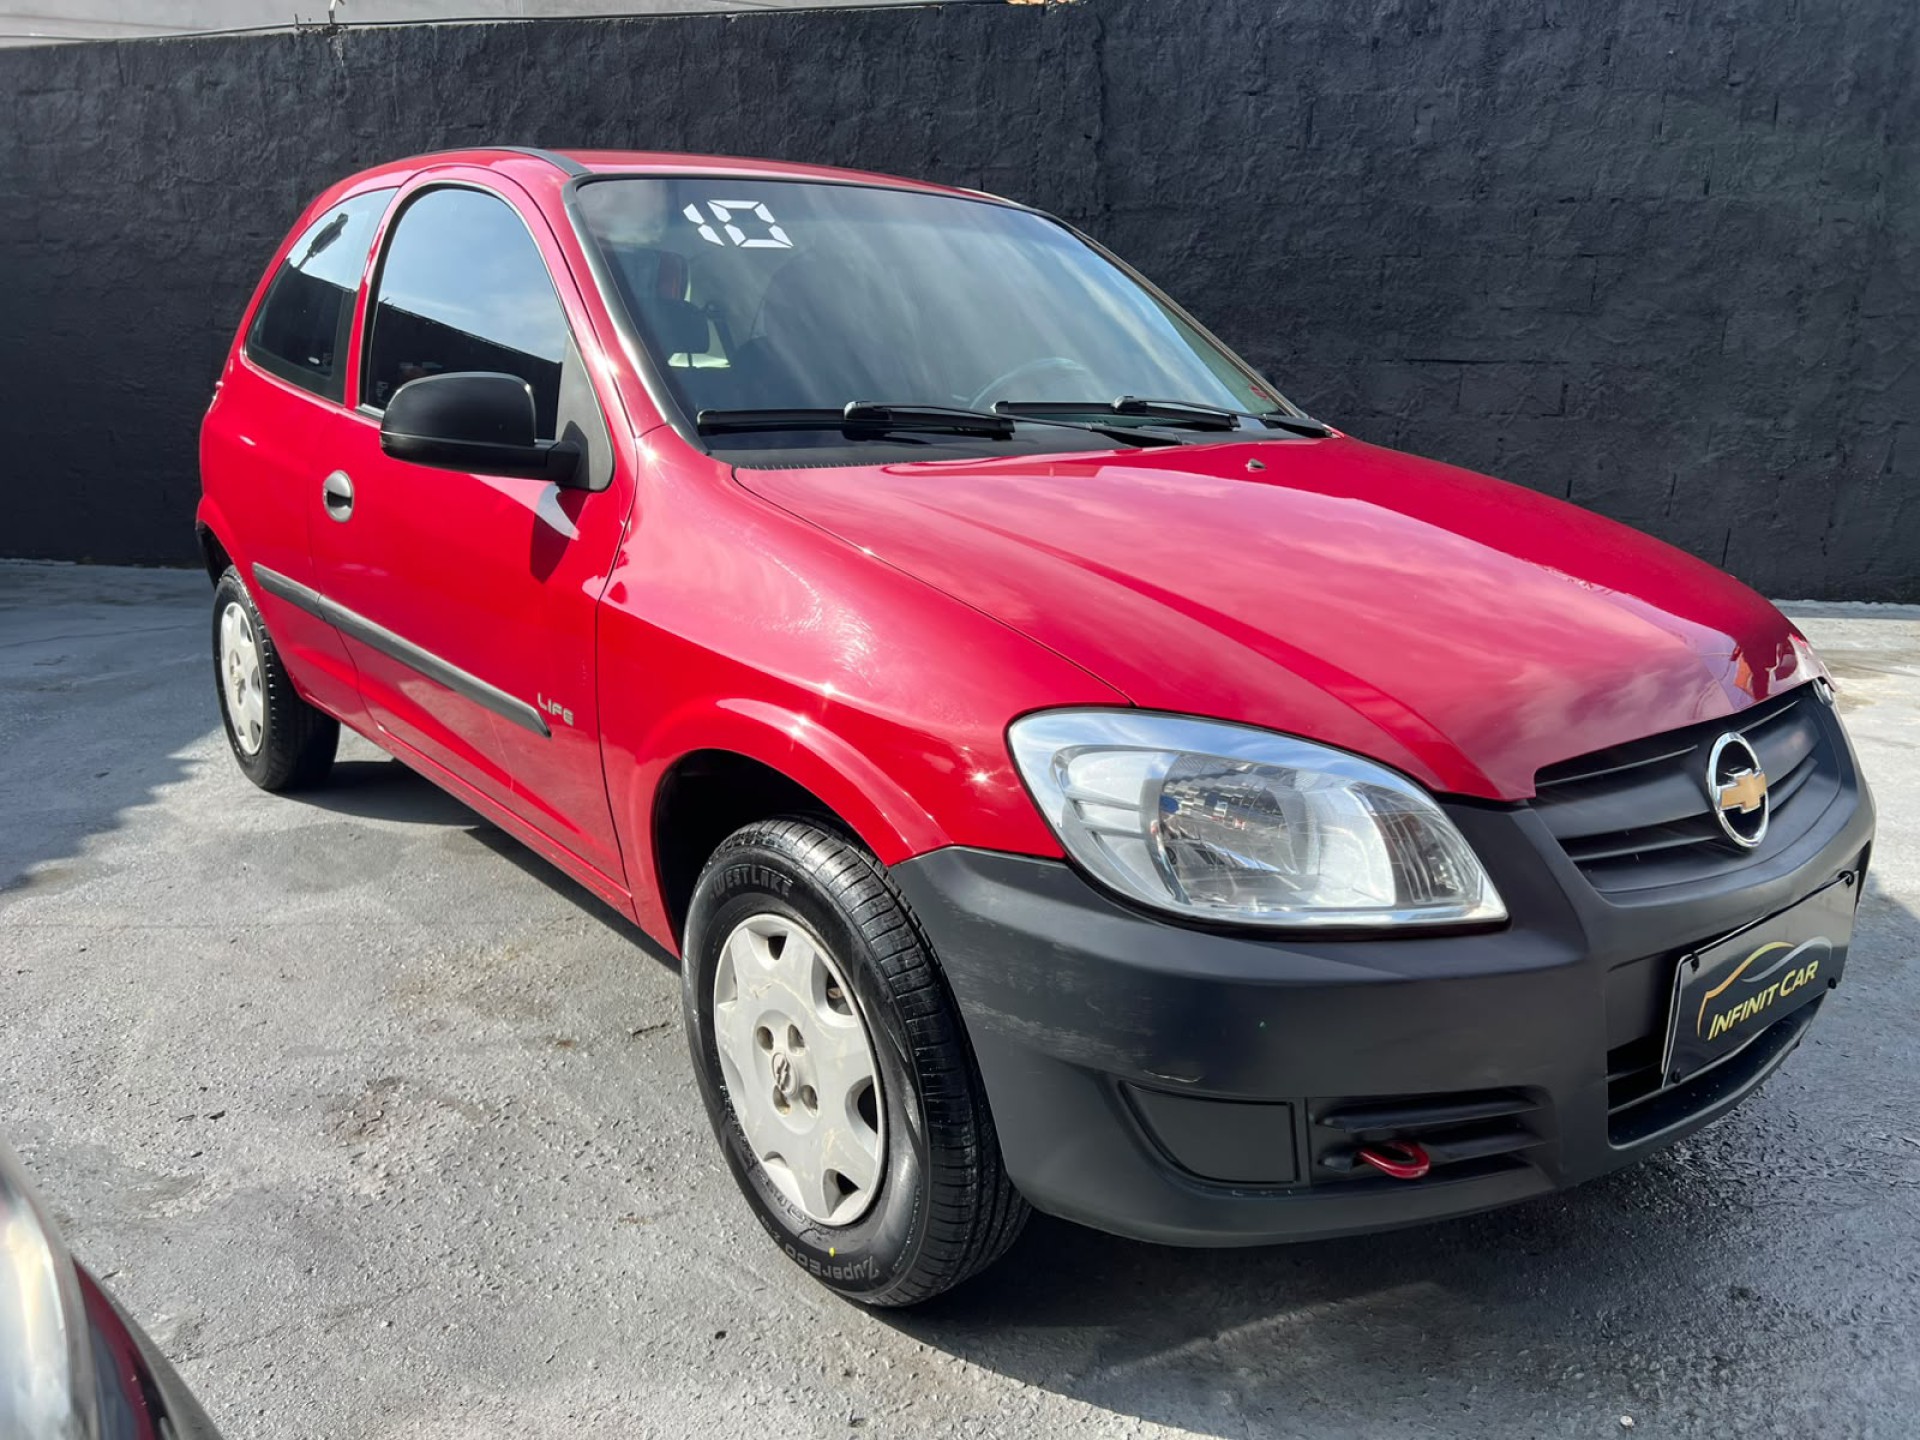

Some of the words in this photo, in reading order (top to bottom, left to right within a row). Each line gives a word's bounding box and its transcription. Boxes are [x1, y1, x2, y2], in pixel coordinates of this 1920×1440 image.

[683, 200, 794, 249] 10
[537, 692, 574, 727] LIFE
[712, 864, 792, 898] WESTLAKE
[1707, 982, 1780, 1041] INFINIT
[1779, 960, 1819, 997] CAR
